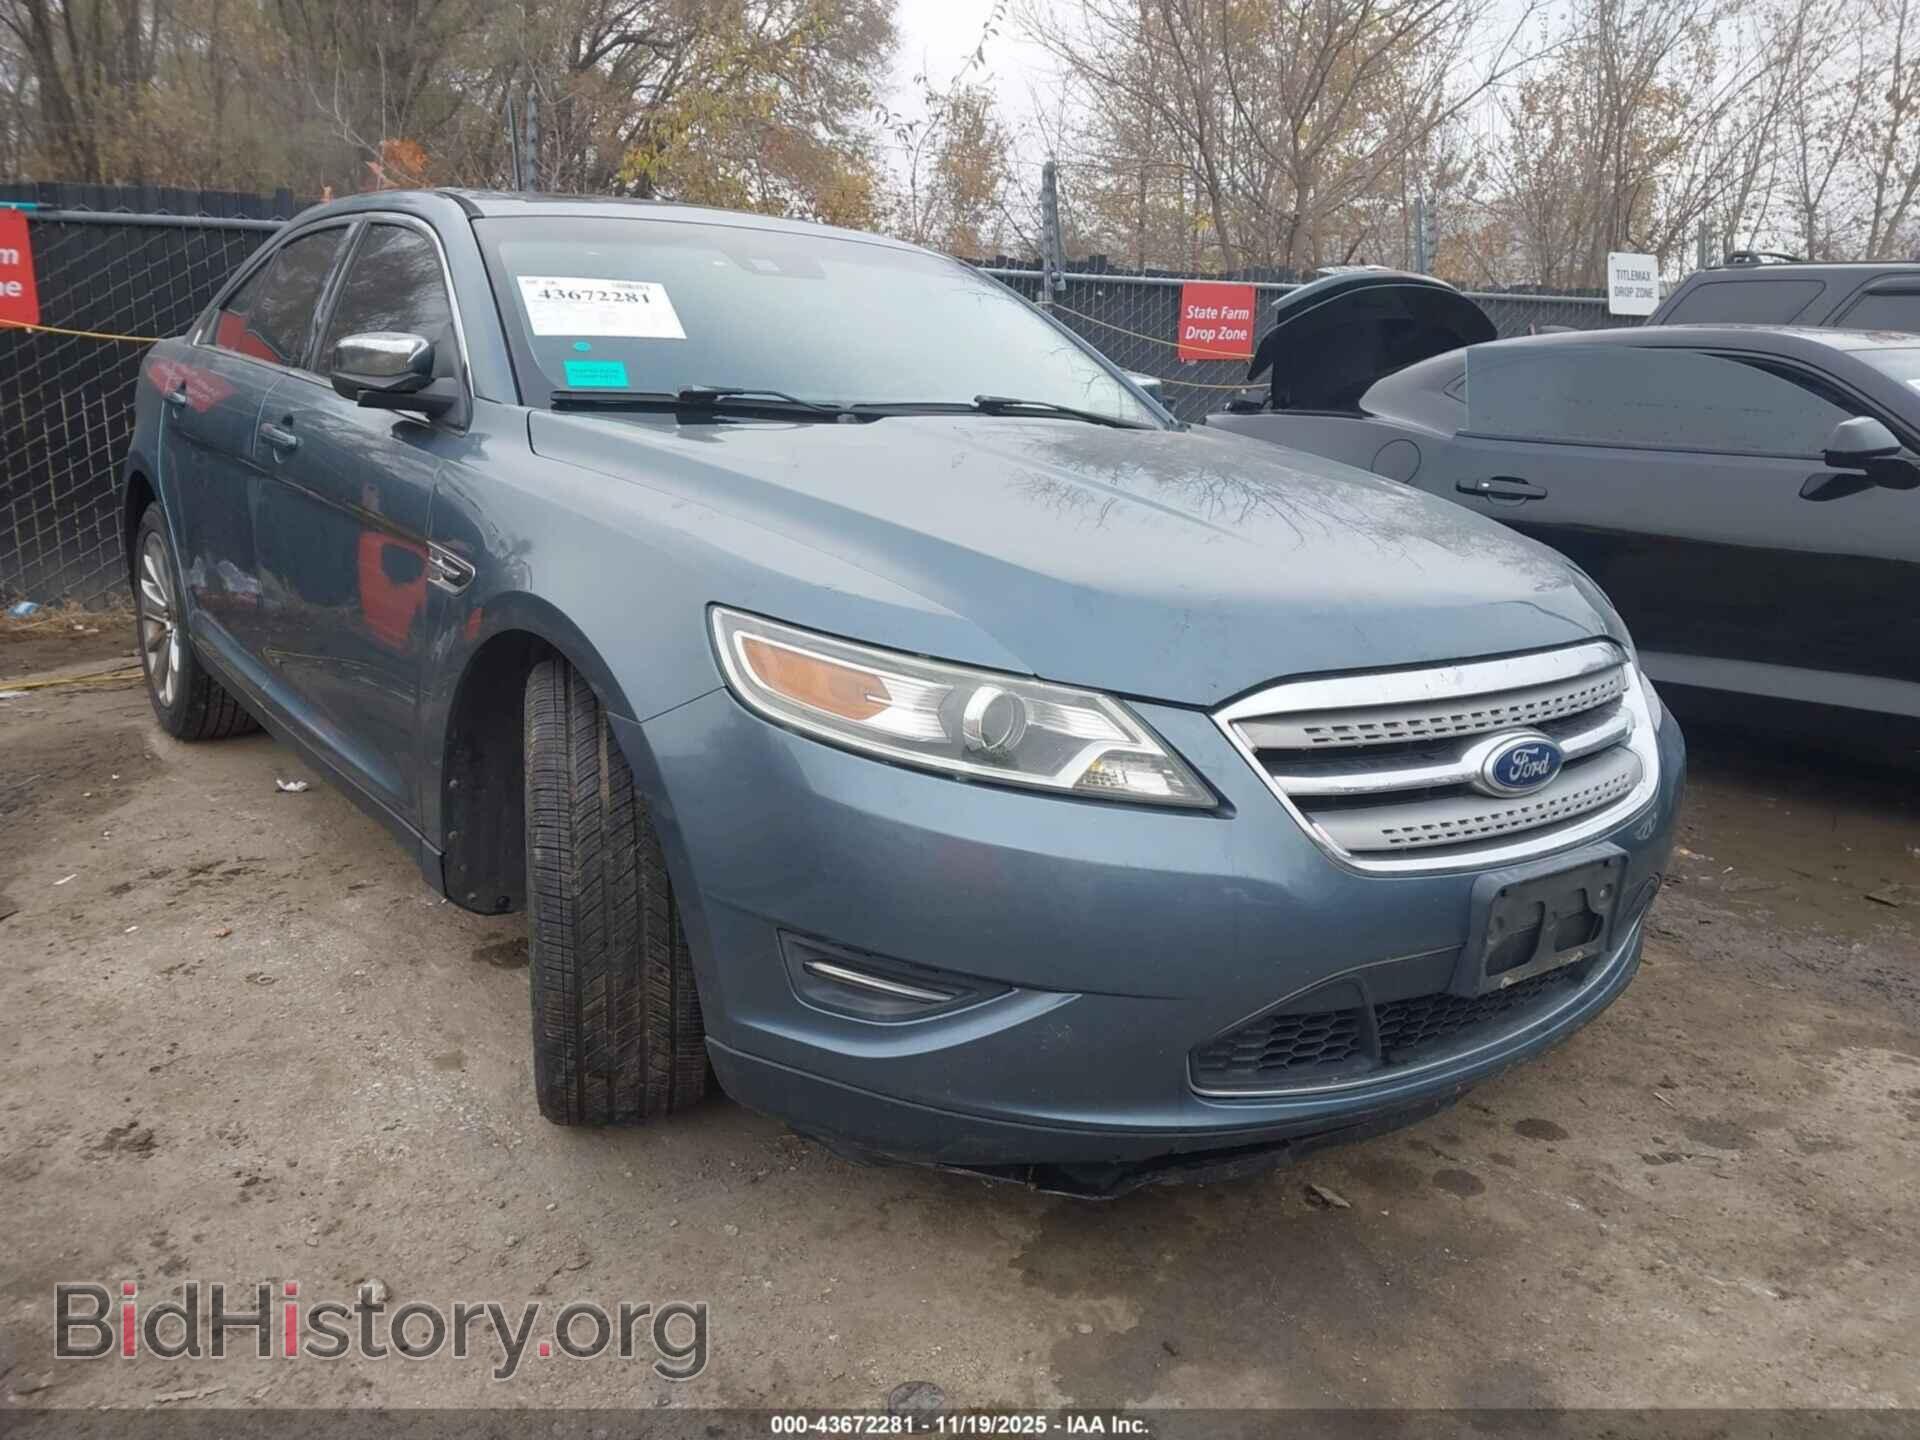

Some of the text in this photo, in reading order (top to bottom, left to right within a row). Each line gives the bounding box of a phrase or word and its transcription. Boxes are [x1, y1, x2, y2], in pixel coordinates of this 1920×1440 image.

[537, 289, 650, 304] 43672281
[1614, 286, 1654, 298] DROP ZONE
[1186, 304, 1249, 321] State Farm
[1185, 326, 1247, 344] Drop Zone
[1508, 747, 1550, 781] Ford
